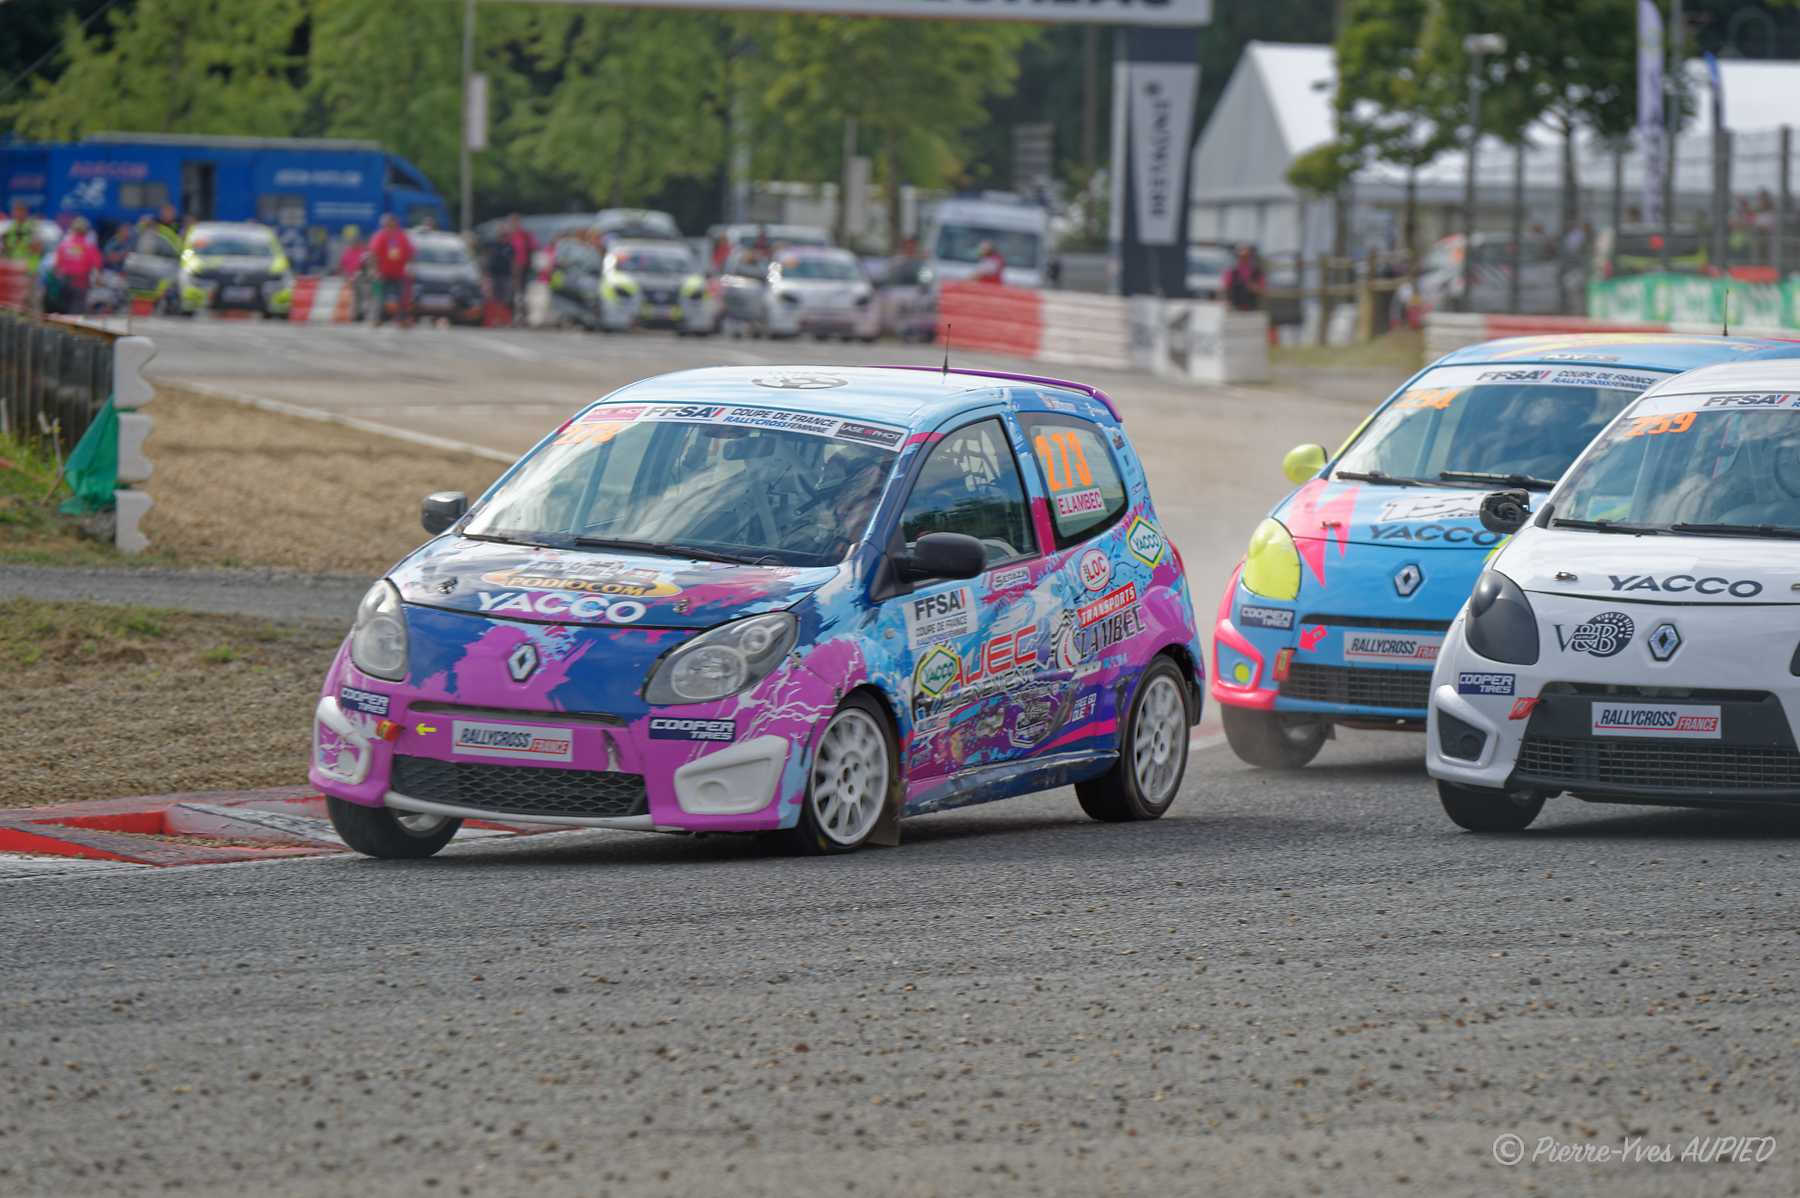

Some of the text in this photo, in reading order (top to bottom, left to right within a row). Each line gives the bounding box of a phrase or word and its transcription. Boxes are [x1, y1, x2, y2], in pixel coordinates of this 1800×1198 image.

[1476, 370, 1551, 381] FFSA
[1703, 395, 1779, 406] FFSA
[645, 406, 718, 418] FFSA
[731, 408, 838, 427] COUPE DE FRANCE
[1057, 490, 1102, 515] E.LAMBEC
[1134, 533, 1160, 549] YACCO
[1370, 524, 1502, 546] YACCO
[1086, 556, 1107, 581] LOC
[507, 576, 648, 596] PODIOCOM
[1608, 575, 1763, 598] YACCO
[478, 591, 647, 623] YACCO
[914, 589, 966, 620] FFSA
[1081, 586, 1136, 624] TRANSPORTS
[1241, 607, 1293, 622] COOPER
[1262, 618, 1291, 628] TIRES
[915, 615, 967, 637] COUPE DE FRANCE
[1351, 638, 1417, 655] RALLYCROSS
[1459, 673, 1513, 686] COOPER
[341, 687, 389, 706] COOPER
[1479, 685, 1512, 694] TIRES
[358, 702, 388, 714] TIRES
[651, 719, 736, 732] COOPER
[1601, 709, 1717, 731] RALLYCROSS FRANCE
[462, 728, 569, 754] RALLYCROSS FRANCE
[689, 731, 733, 740] TIRES
